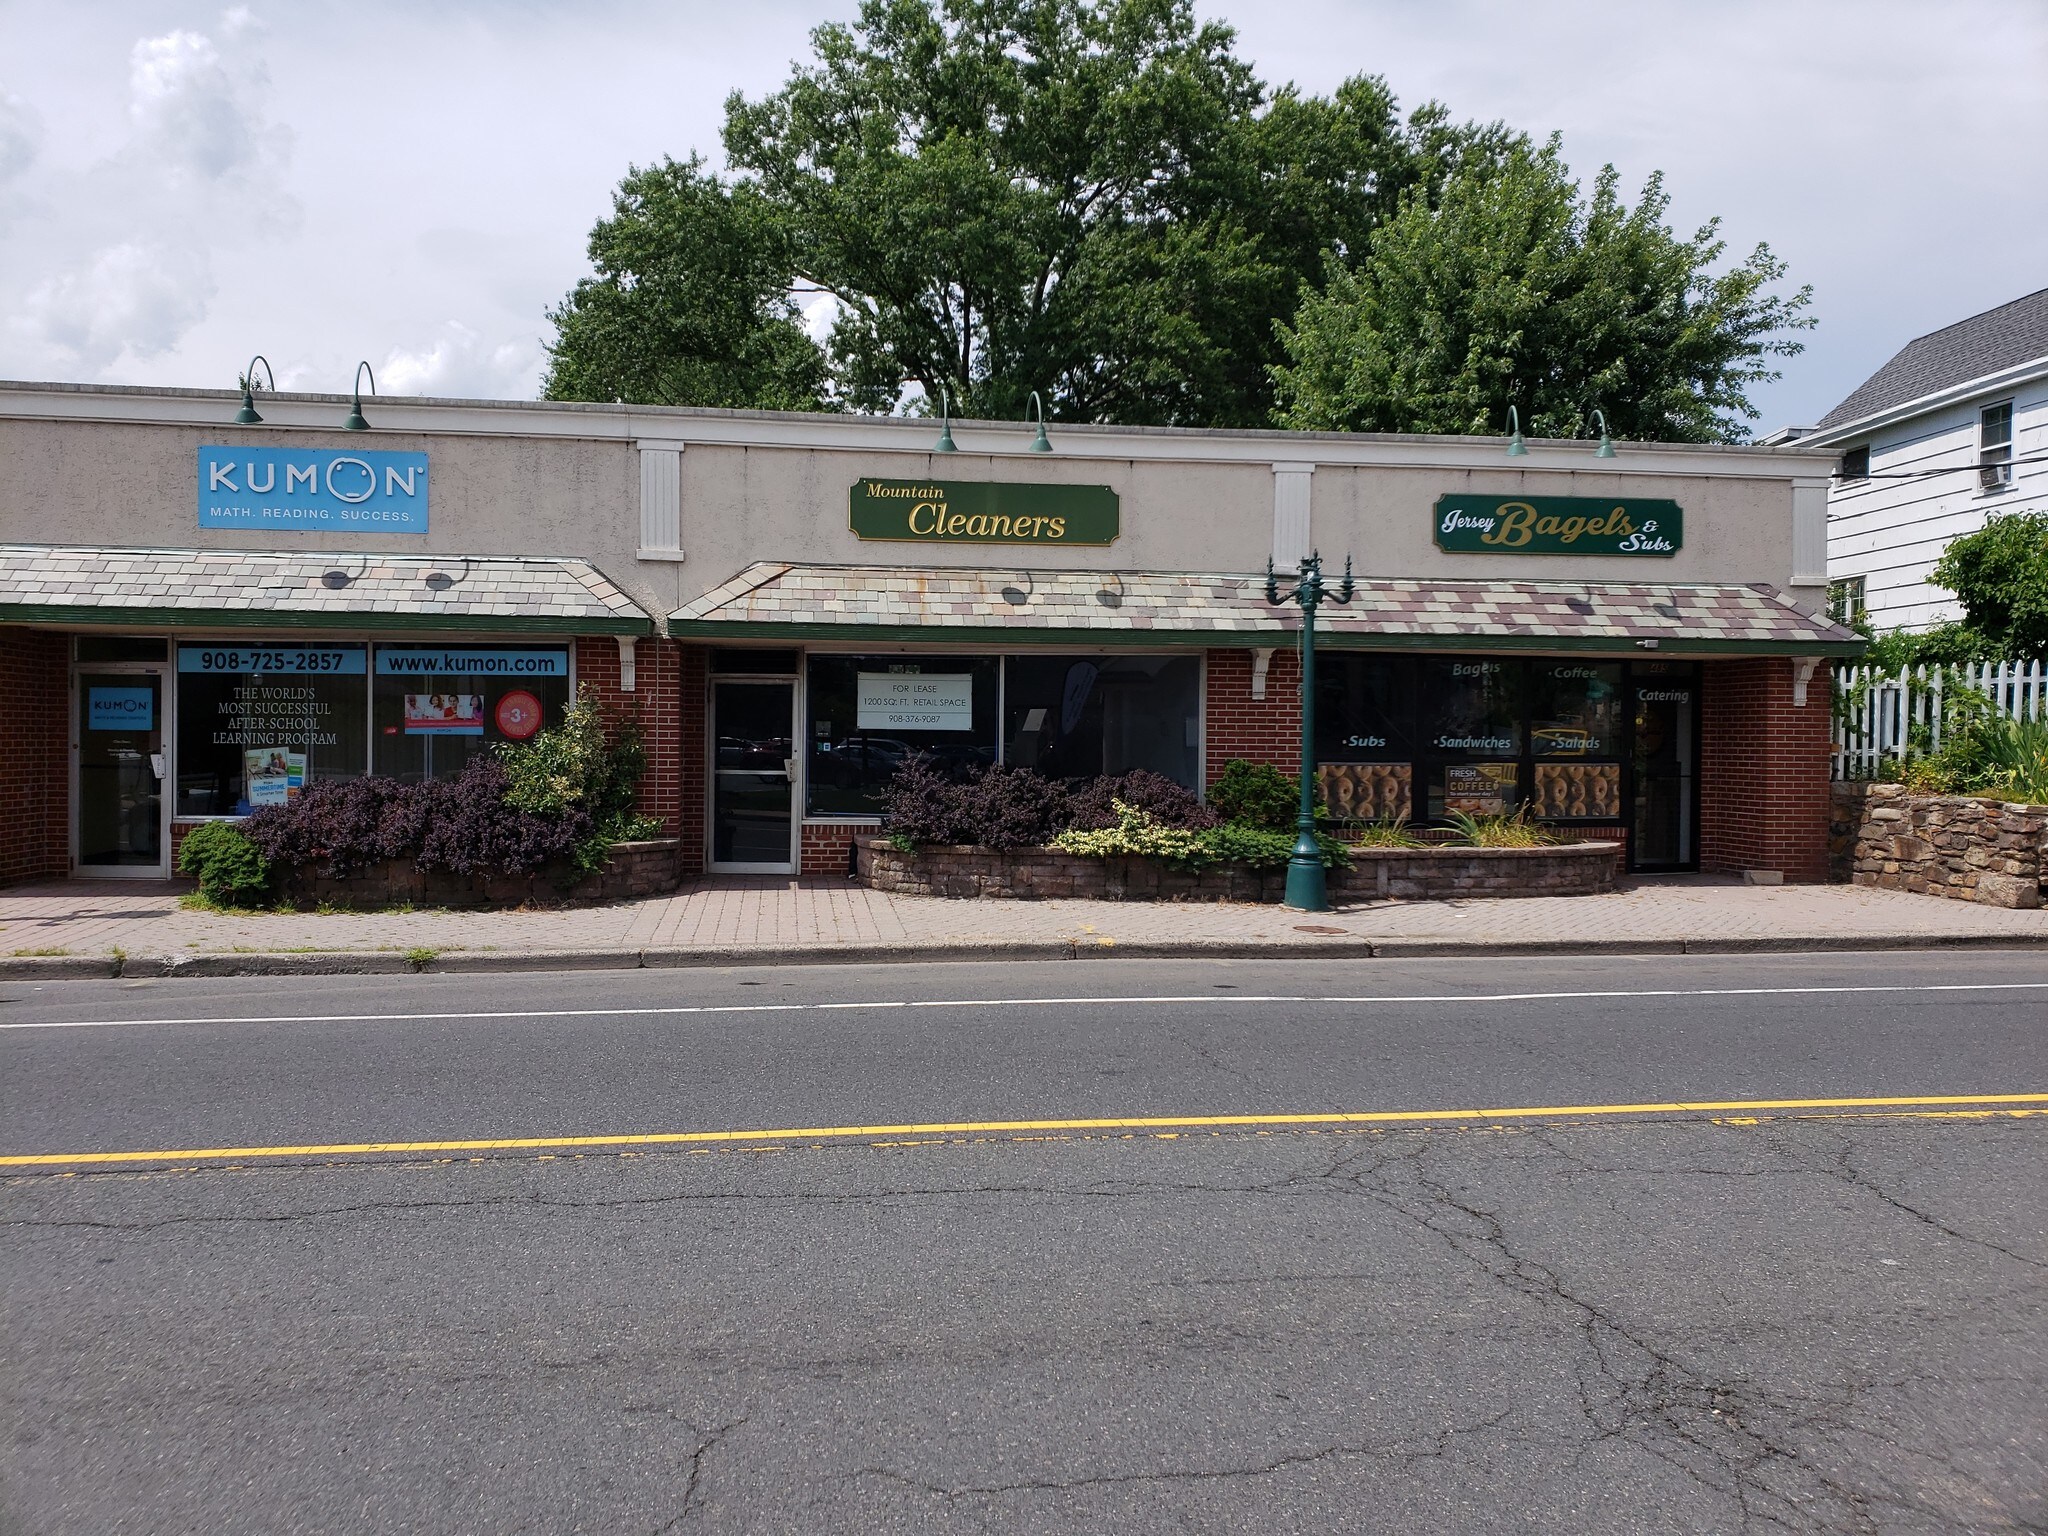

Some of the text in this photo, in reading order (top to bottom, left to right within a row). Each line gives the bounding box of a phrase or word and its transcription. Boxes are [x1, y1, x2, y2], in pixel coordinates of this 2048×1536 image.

[210, 457, 416, 503] KUMON
[867, 483, 944, 499] Mountain
[210, 507, 414, 522] MATH. READING. SUCCESS.
[908, 502, 1066, 538] Cleaners
[1441, 502, 1660, 547] Jersey Bagels &
[1619, 533, 1675, 551] Subs
[201, 651, 344, 671] 908-725-2857
[388, 653, 555, 672] www.kumon.com
[1452, 663, 1501, 678] Bagels
[1553, 667, 1598, 678] Coffee
[233, 687, 315, 700] THE WORLD'S
[913, 685, 937, 693] LEASE
[900, 698, 909, 706] FT.
[913, 698, 938, 706] RETAIL
[940, 699, 966, 707] SPACE
[1638, 689, 1690, 704] Catering
[94, 699, 147, 713] KUMON
[218, 702, 331, 715] MOST SUCCESSFUL
[227, 717, 320, 730] AFTER-SCHOOL
[888, 714, 941, 723] 908-376-9087
[213, 732, 337, 745] LEARNING PROGRAM
[1348, 735, 1387, 747] Subs
[1438, 735, 1511, 748] Sandwiches
[1556, 736, 1601, 749] Salads
[1450, 781, 1493, 791] COFFEE
